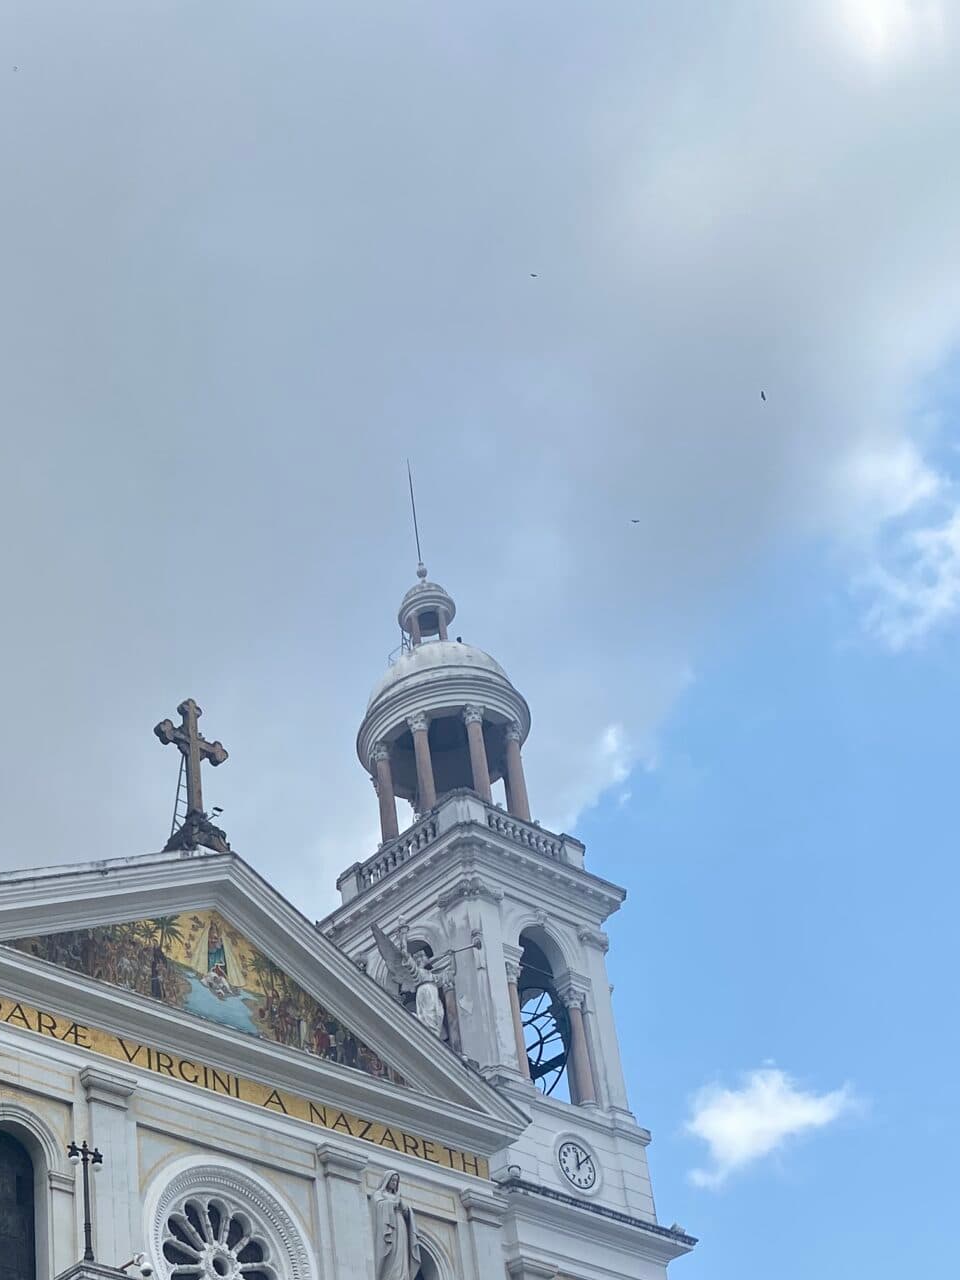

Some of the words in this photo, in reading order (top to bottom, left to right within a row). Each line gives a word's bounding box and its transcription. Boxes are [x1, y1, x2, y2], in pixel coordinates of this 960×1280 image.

[116, 1037, 240, 1099] VIRGINI
[263, 1089, 288, 1114] A
[308, 1102, 479, 1177] NAZARETH
